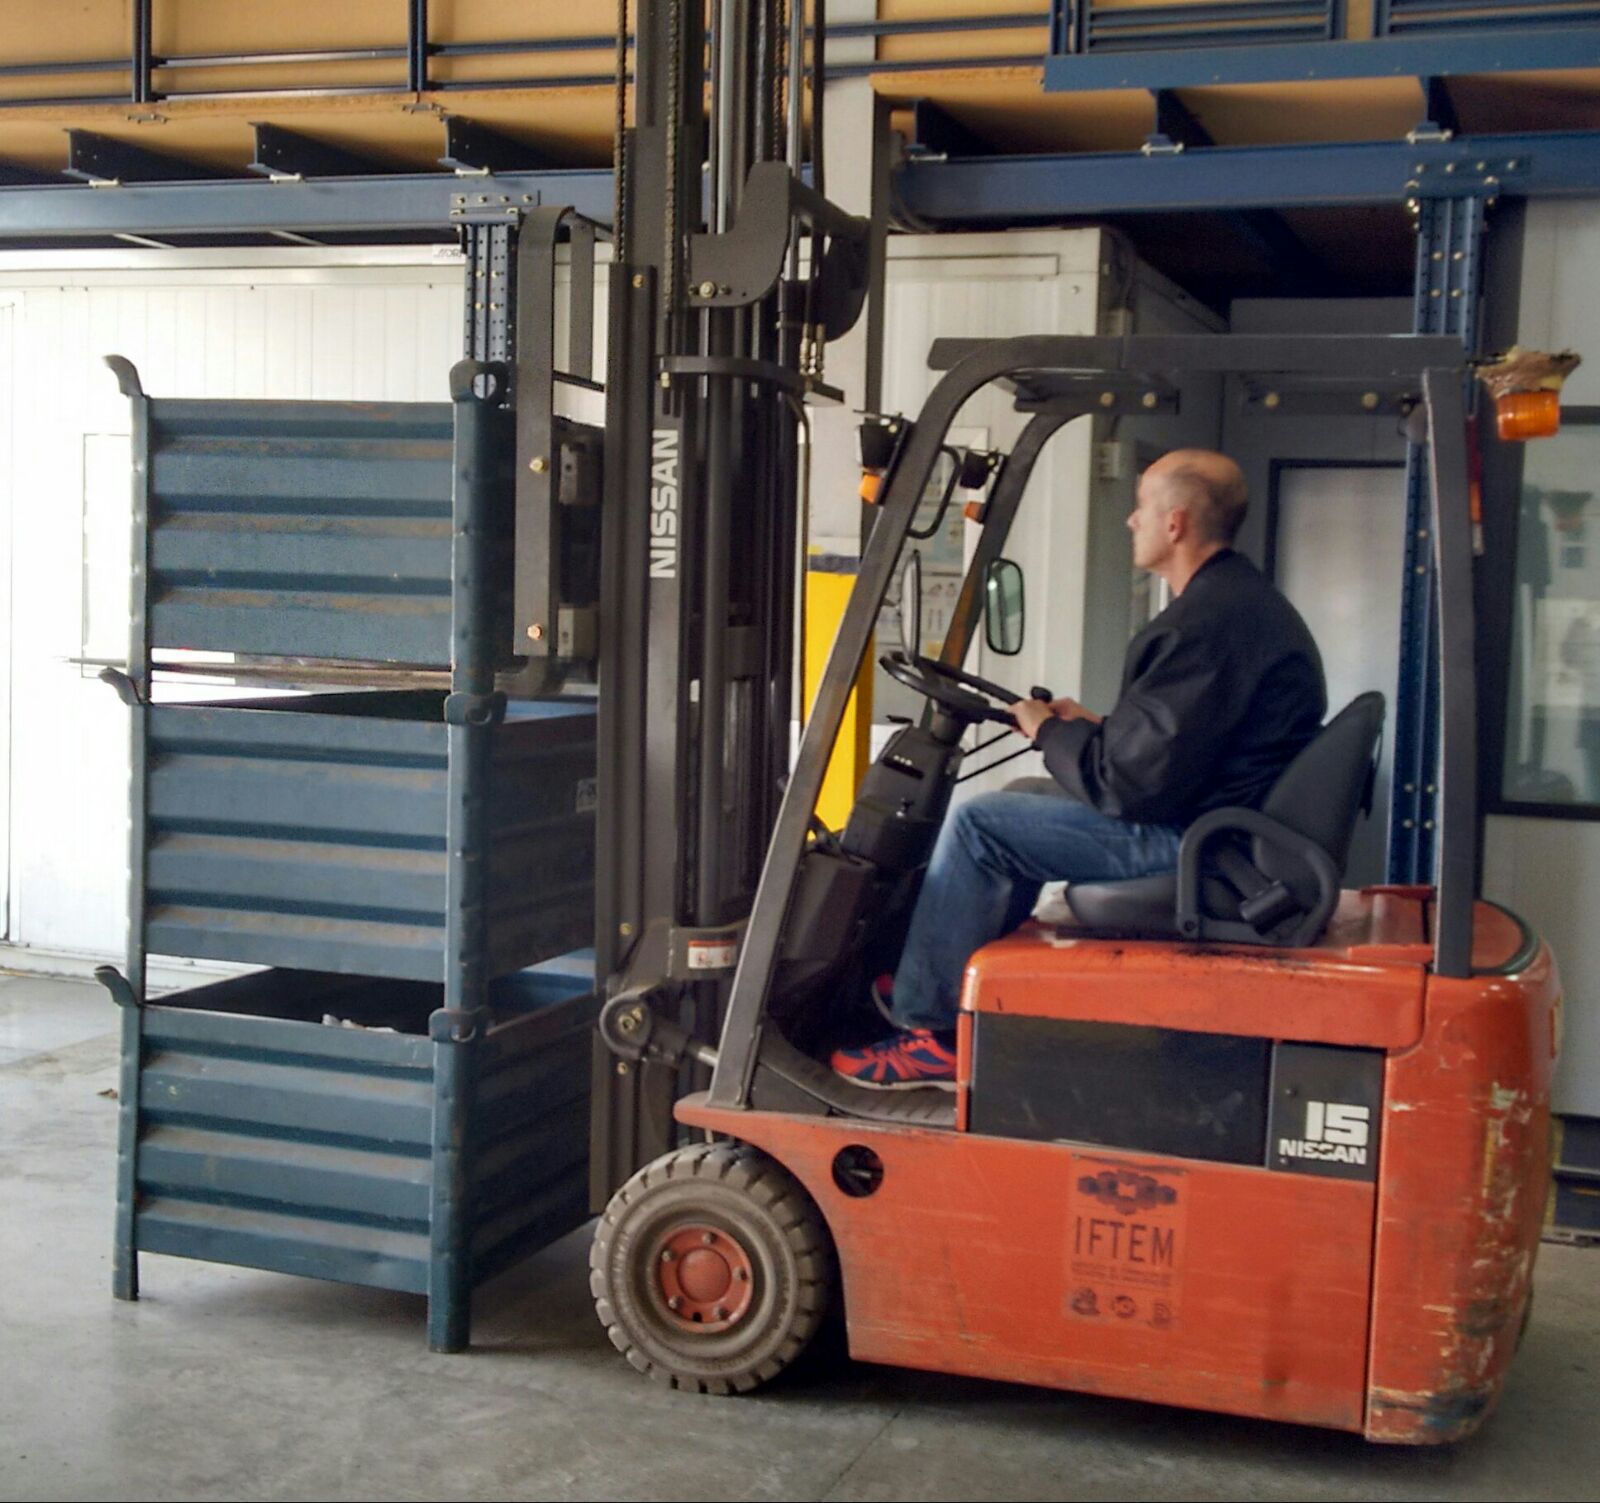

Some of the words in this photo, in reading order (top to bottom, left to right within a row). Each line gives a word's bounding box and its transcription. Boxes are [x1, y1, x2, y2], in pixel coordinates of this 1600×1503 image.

[650, 429, 679, 579] NISSAN
[1306, 1101, 1370, 1147] 15
[1279, 1138, 1367, 1165] NISSAN
[1073, 1216, 1174, 1267] IFTEM
